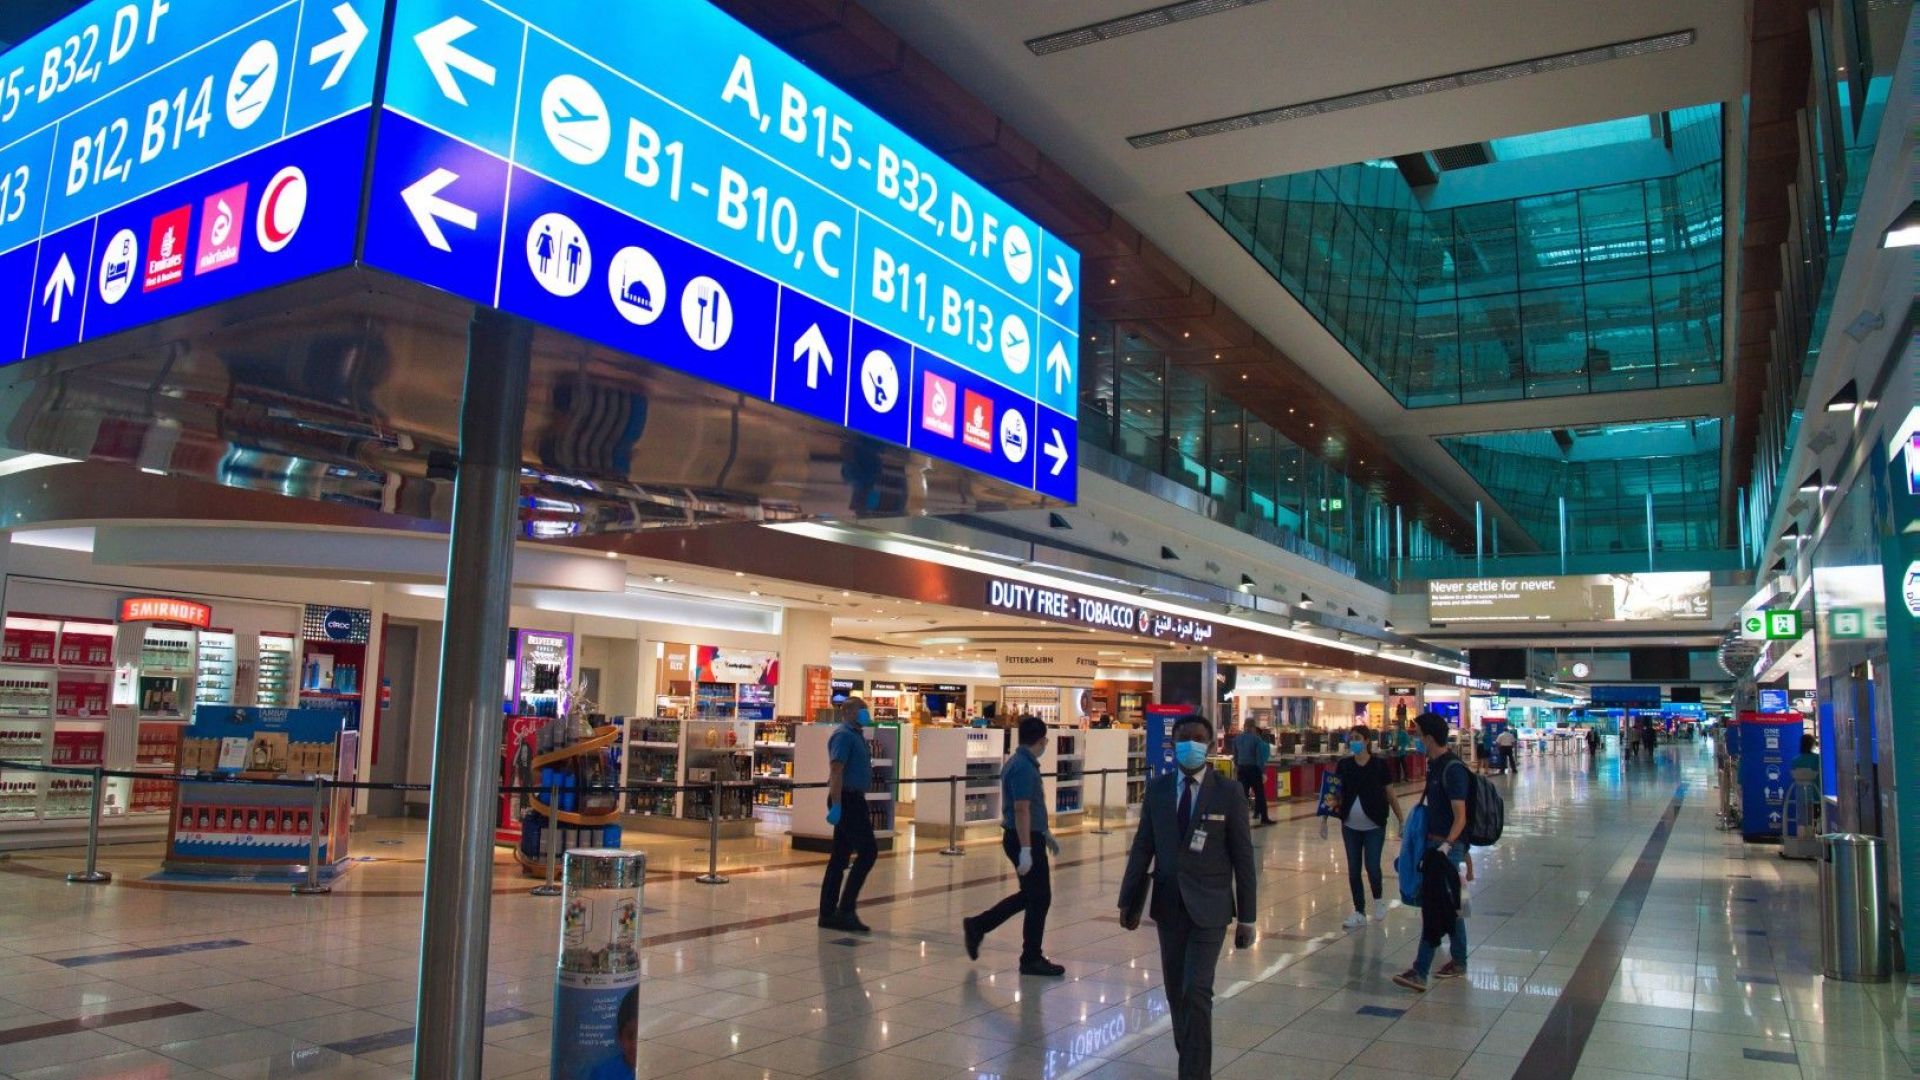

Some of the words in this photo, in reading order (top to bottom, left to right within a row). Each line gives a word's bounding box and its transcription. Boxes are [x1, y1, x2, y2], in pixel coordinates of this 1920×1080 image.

[66, 117, 132, 197] B12,
[140, 74, 214, 165] B14
[813, 220, 842, 279] C
[149, 253, 182, 275] Emirates
[942, 284, 994, 354] B13
[1431, 581, 1463, 592] Never
[1466, 580, 1498, 592] settle
[1501, 580, 1518, 591] for
[1521, 580, 1556, 591] never.
[129, 601, 205, 621] SMIRNOFF
[991, 580, 1035, 611] DUTY
[1037, 590, 1068, 618] FREE
[1079, 598, 1134, 629] TOBACCO
[1155, 614, 1172, 637] التبغ
[1178, 618, 1193, 639] الحرة
[1194, 622, 1212, 642] السوق
[1005, 655, 1054, 665] FETTERCAIRN
